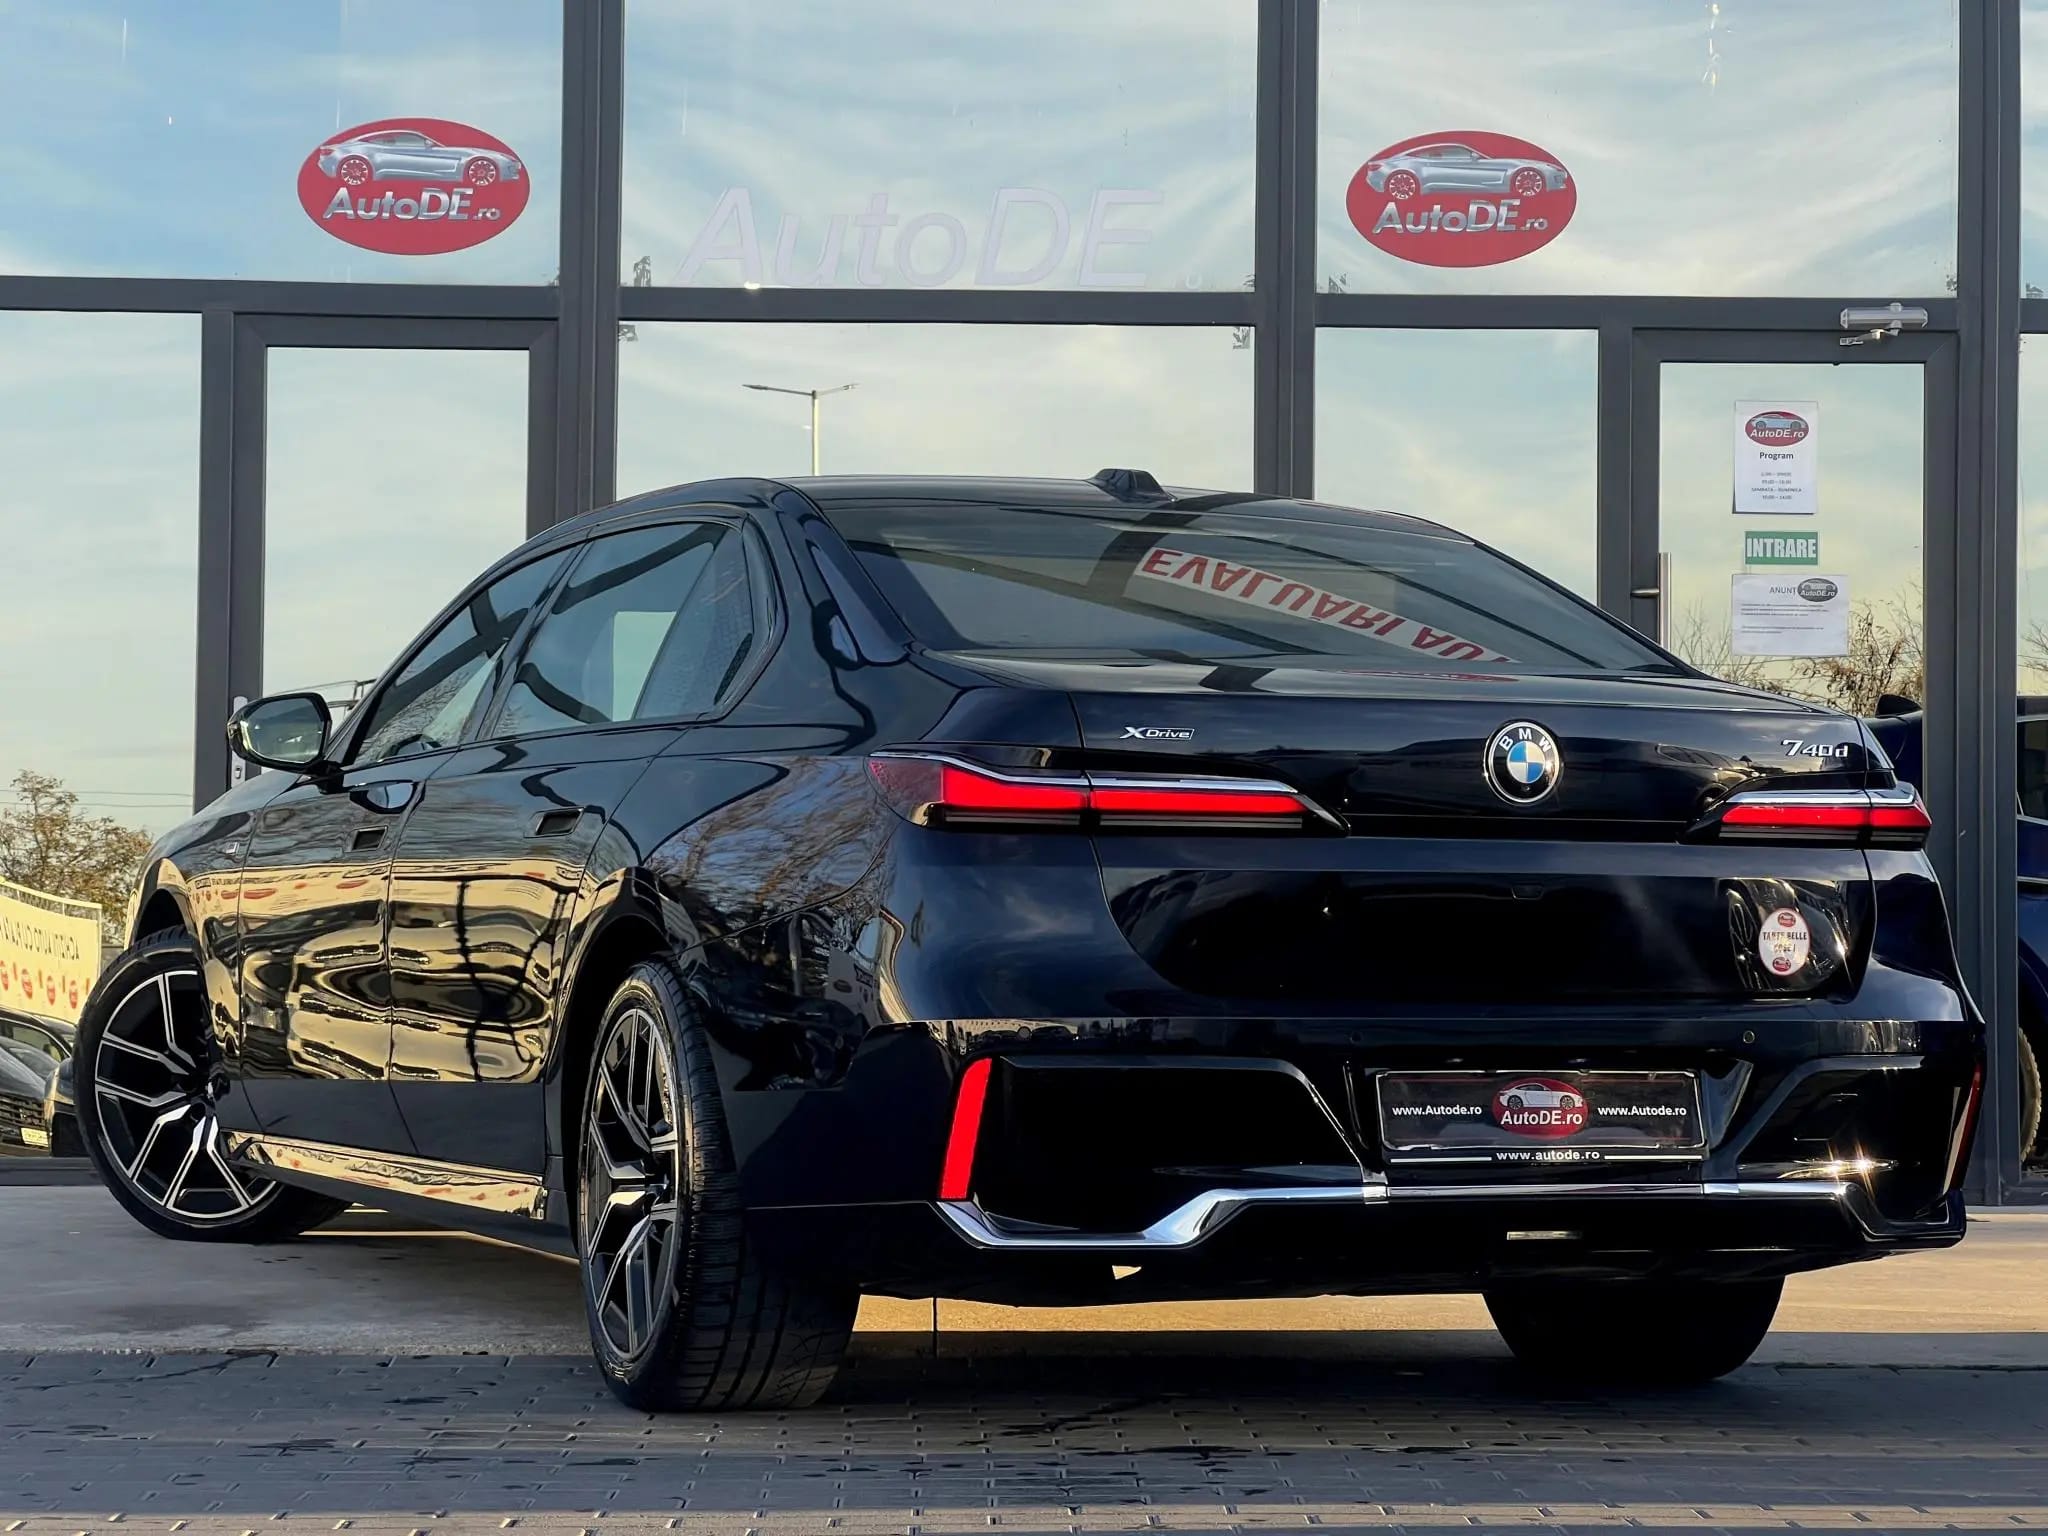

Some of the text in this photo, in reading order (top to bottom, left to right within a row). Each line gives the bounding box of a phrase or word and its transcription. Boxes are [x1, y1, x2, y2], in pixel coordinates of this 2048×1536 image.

[322, 186, 500, 221] AutoDE.ro
[1372, 198, 1548, 234] AutoDE.ro
[673, 186, 1164, 288] AutoDE
[1750, 428, 1805, 438] AutoDE.ro
[1759, 451, 1794, 461] Program
[1746, 538, 1817, 558] INTRARE
[1498, 728, 1552, 752] BMW
[1782, 739, 1849, 758] 740d
[1391, 1104, 1483, 1117] www.Autode.ro
[1500, 1109, 1584, 1126] AutoDE.ro
[1597, 1104, 1688, 1117] www.Autode.ro
[1495, 1149, 1601, 1162] www.autode.ro
